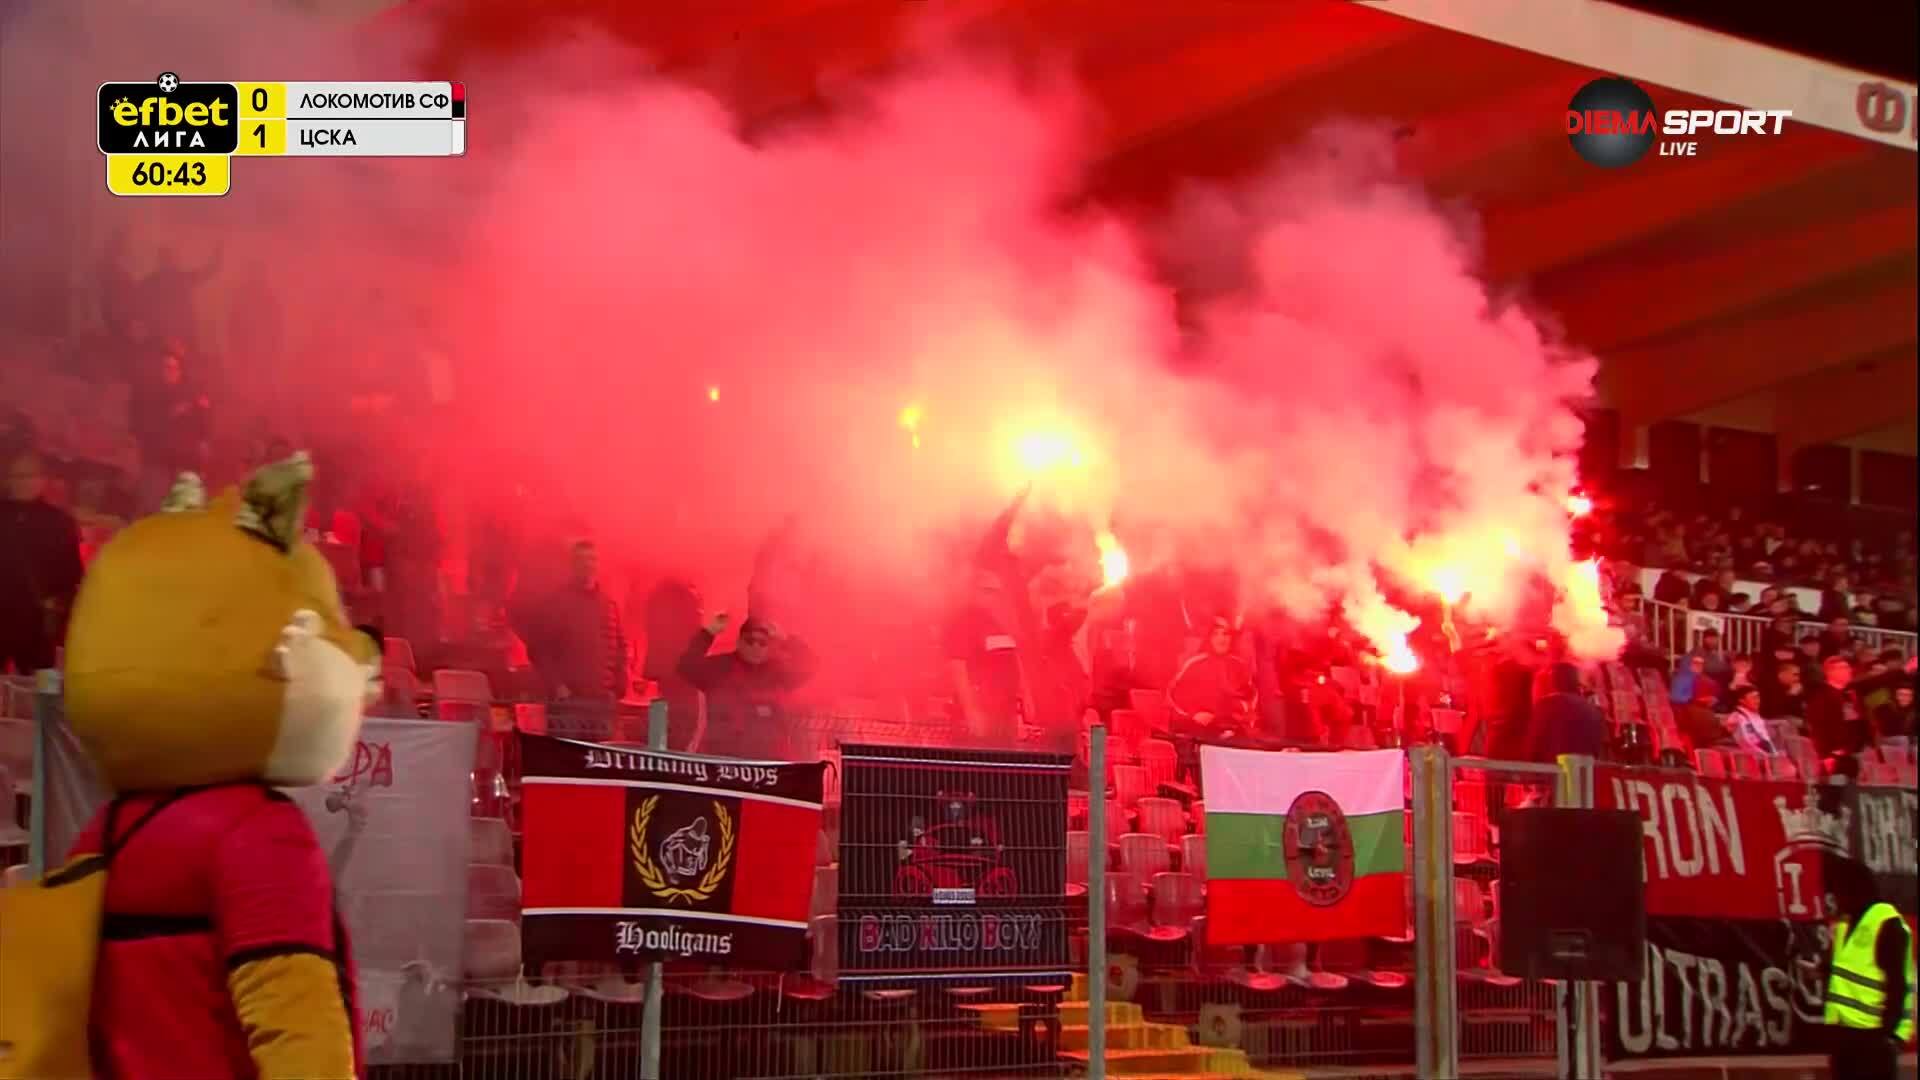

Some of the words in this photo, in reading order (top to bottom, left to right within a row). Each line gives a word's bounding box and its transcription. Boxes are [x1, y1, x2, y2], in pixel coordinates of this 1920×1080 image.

[615, 920, 733, 957] Hooligans
[859, 914, 918, 952] BAD
[919, 914, 979, 951] KILO
[1616, 938, 1792, 1053] ULTRAS
